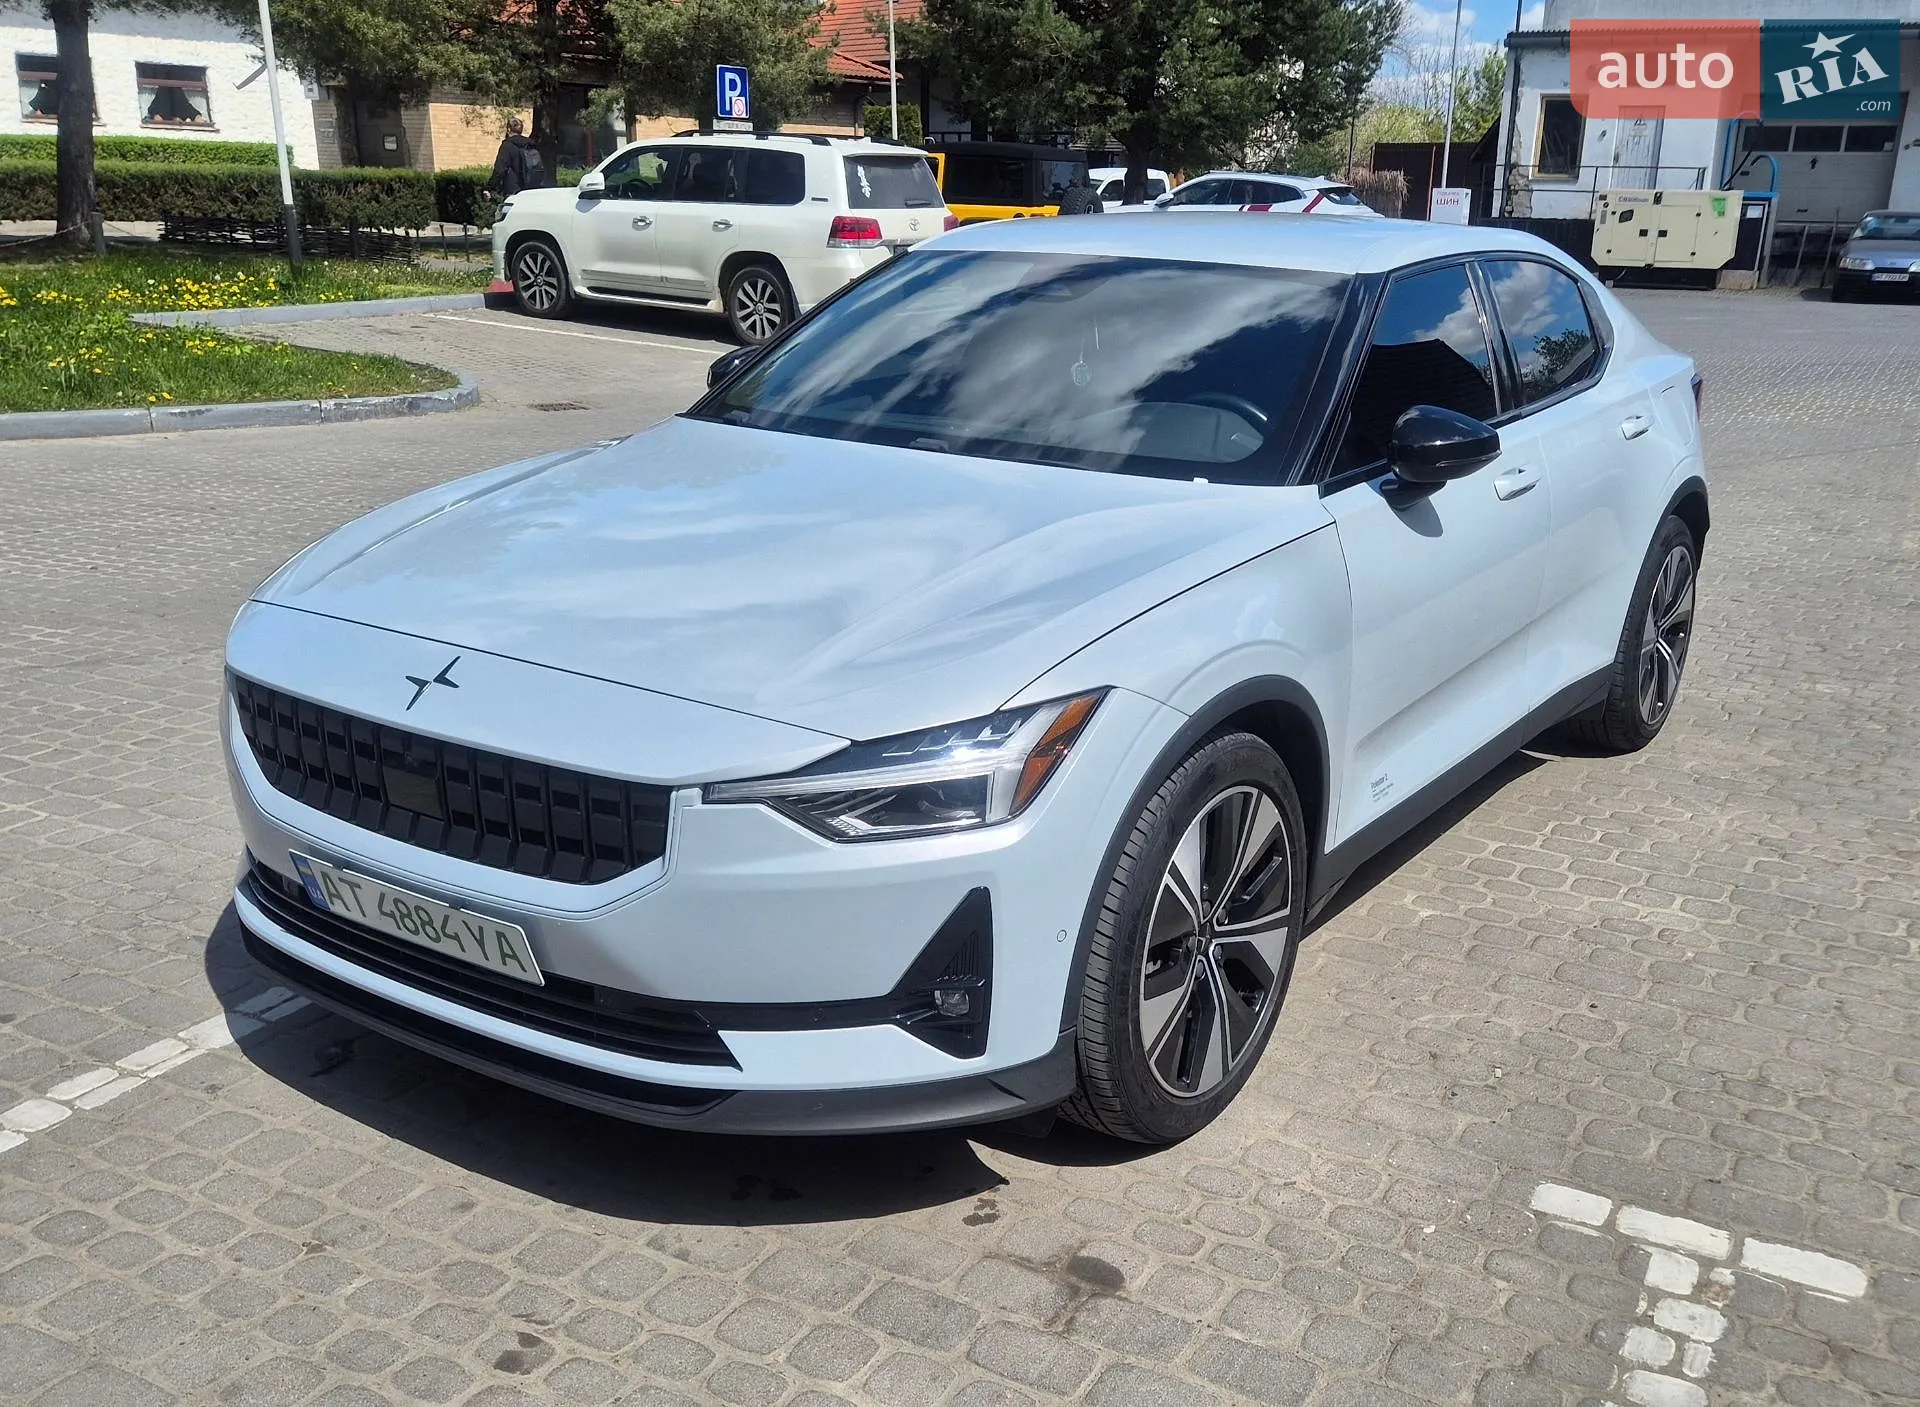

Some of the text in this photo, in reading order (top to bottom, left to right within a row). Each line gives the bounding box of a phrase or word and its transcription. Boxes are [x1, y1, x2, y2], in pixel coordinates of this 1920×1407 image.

[724, 71, 742, 111] P
[308, 886, 326, 903] UA
[320, 870, 528, 973] AT 4884 YA
